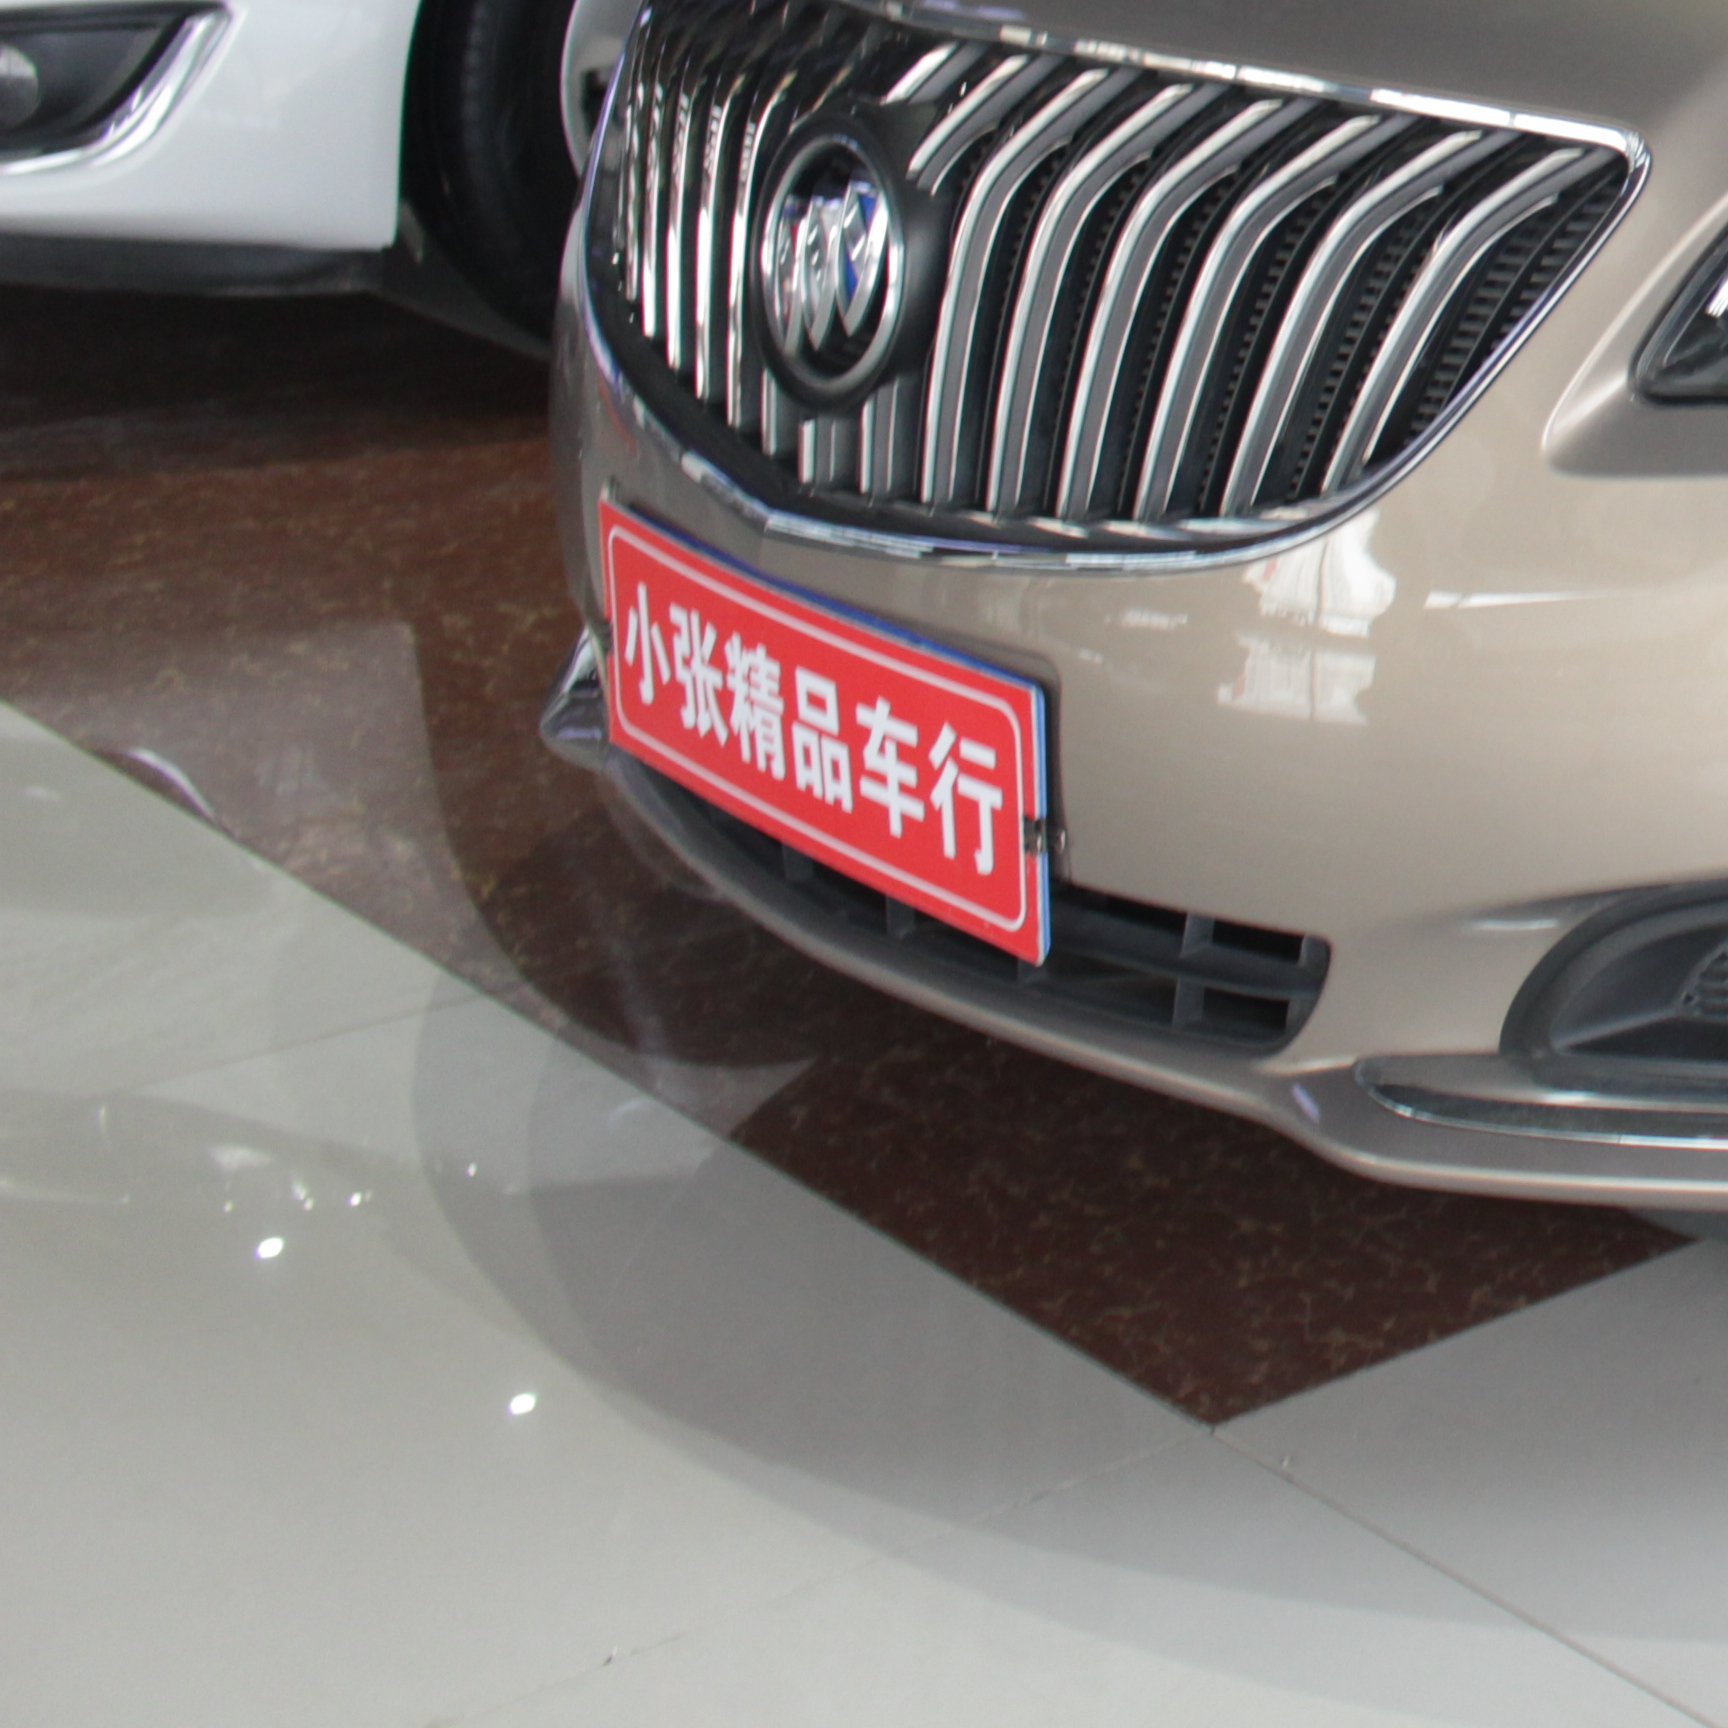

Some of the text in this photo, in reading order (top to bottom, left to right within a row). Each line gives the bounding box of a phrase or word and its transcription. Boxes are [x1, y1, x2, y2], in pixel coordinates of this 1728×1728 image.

[623, 579, 1005, 878] 小张精品车行
